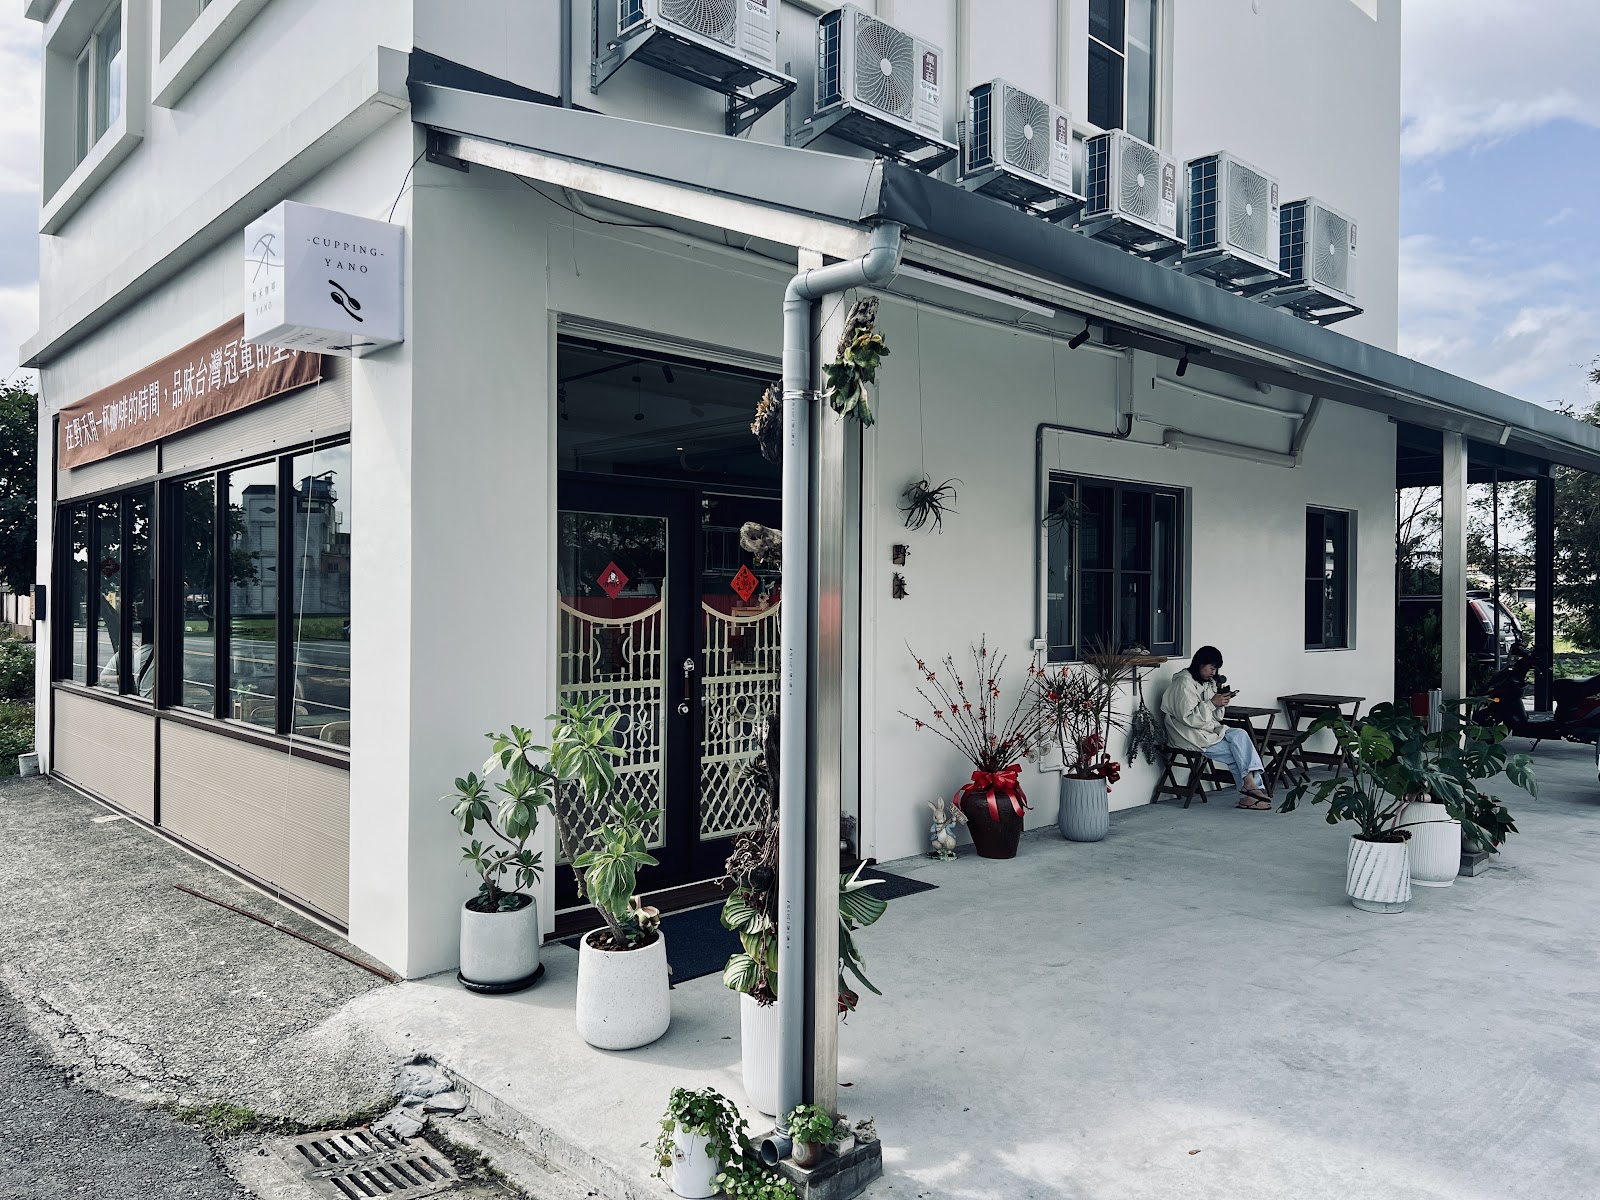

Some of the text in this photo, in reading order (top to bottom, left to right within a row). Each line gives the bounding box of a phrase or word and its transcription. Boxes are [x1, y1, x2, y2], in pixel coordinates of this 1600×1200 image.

[1164, 166, 1174, 202] 萬士益
[325, 258, 369, 274] YANO
[256, 300, 272, 317] YANO
